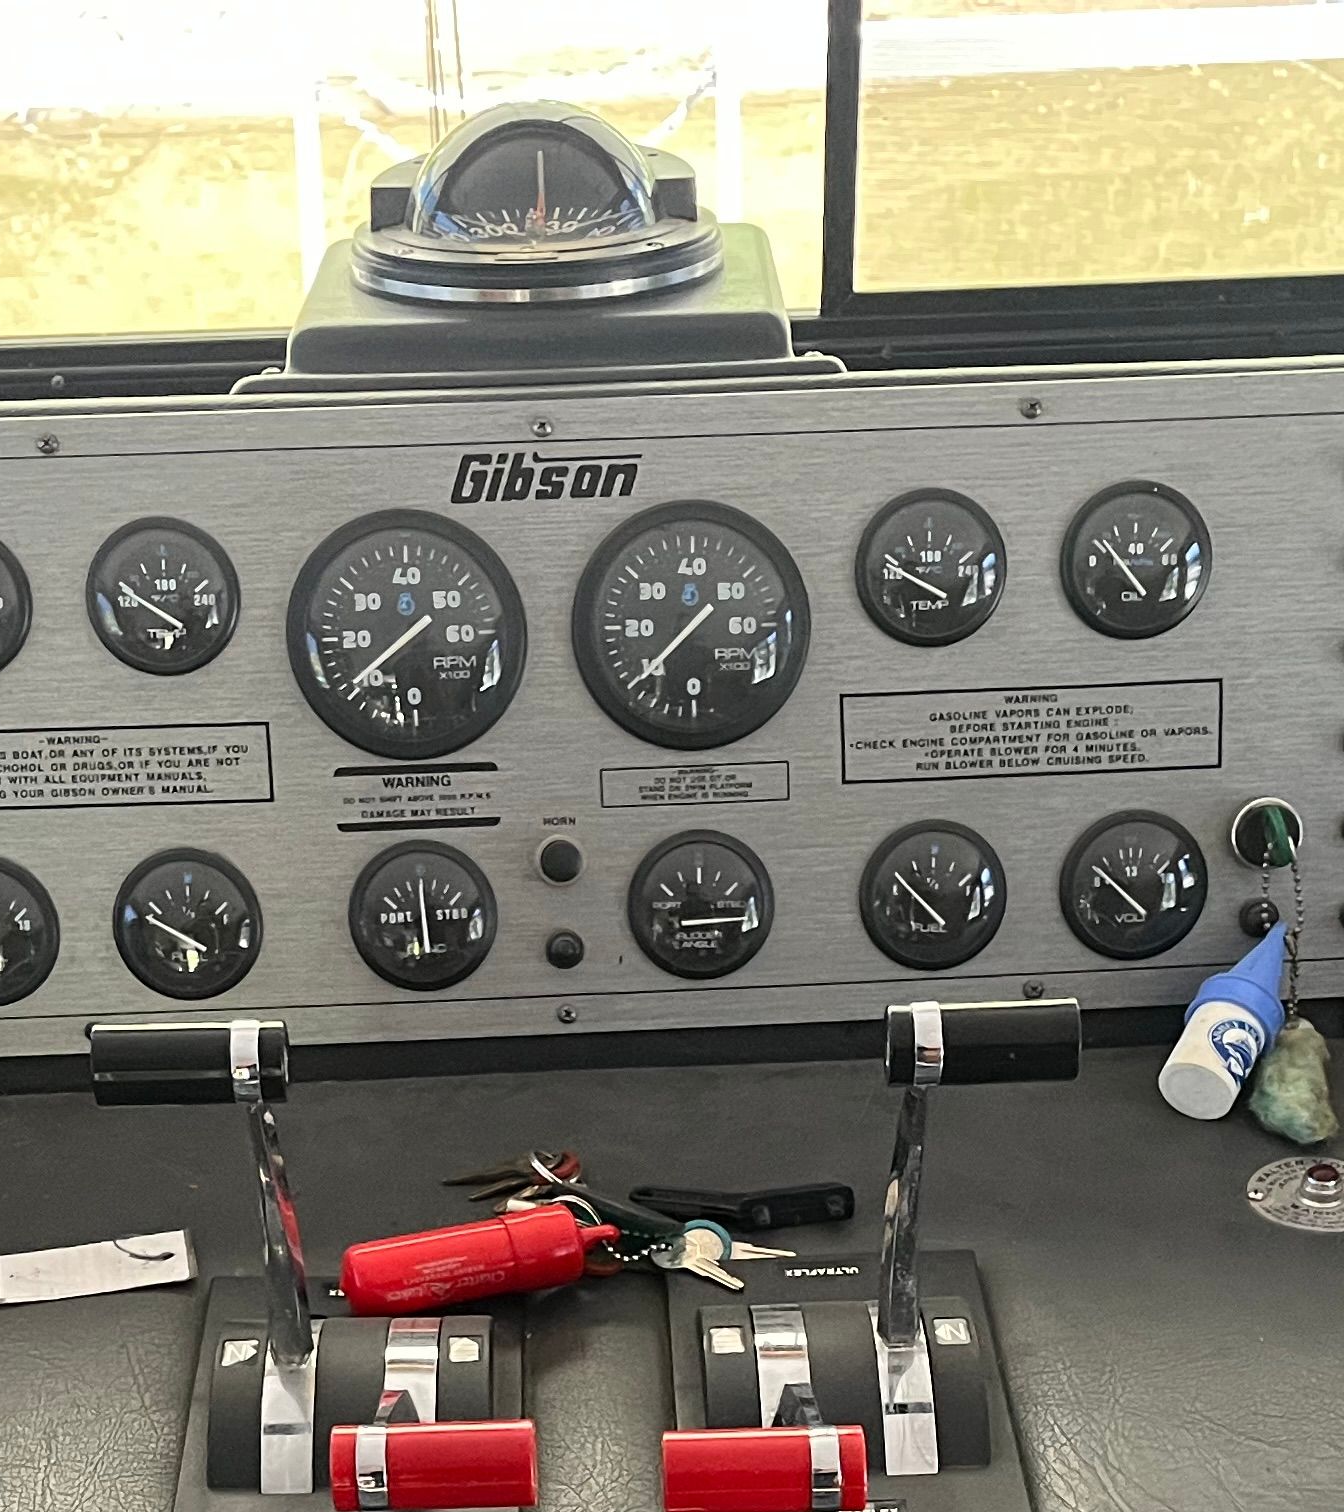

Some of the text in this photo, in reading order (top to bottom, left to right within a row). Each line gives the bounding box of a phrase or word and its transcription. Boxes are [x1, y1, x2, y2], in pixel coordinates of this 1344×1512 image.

[451, 452, 640, 504] Gibson
[678, 558, 706, 575] 40
[392, 567, 420, 584] 40
[640, 582, 666, 600] 30
[717, 582, 745, 599] 50
[194, 595, 215, 606] 240
[355, 593, 381, 611] 30
[433, 590, 460, 608] 50
[910, 600, 948, 611] TEMP
[625, 619, 653, 637] 20
[728, 617, 756, 634] 60
[343, 631, 371, 648] 20
[446, 624, 474, 642] 60
[715, 648, 756, 660] RPM
[434, 656, 476, 669] RPM
[687, 678, 700, 695] 0
[407, 687, 421, 705] 0
[929, 707, 1070, 721] GASOLINE VAPORS CAN
[950, 723, 995, 733] BEFORE
[1002, 720, 1060, 731] STARTING
[902, 729, 1156, 748] ENGINE COMPARTMENT FOR GASOLINE OR
[72, 749, 94, 758] ANY
[102, 749, 118, 757] OF
[123, 748, 142, 756] ITS
[224, 745, 248, 754] YOU
[990, 746, 1038, 756] BLOWER
[50, 763, 67, 771] OR
[140, 760, 150, 768] IF
[157, 760, 180, 768] YOU
[187, 758, 209, 767] ARE
[216, 757, 240, 766] NOT
[916, 756, 1101, 771] RUN BLOWER BELOW CRUISING
[8, 776, 38, 784] WITH
[44, 775, 65, 783] ALL
[71, 773, 139, 783] EQUIPMENT
[382, 775, 451, 788] WARNING
[12, 789, 44, 798] YOUR
[51, 788, 96, 798] GIBSON
[361, 809, 406, 818] DAMAGE
[436, 807, 475, 815] RESULT
[543, 817, 575, 826] HORN
[381, 911, 413, 924] PORT
[912, 923, 947, 932] FUEL
